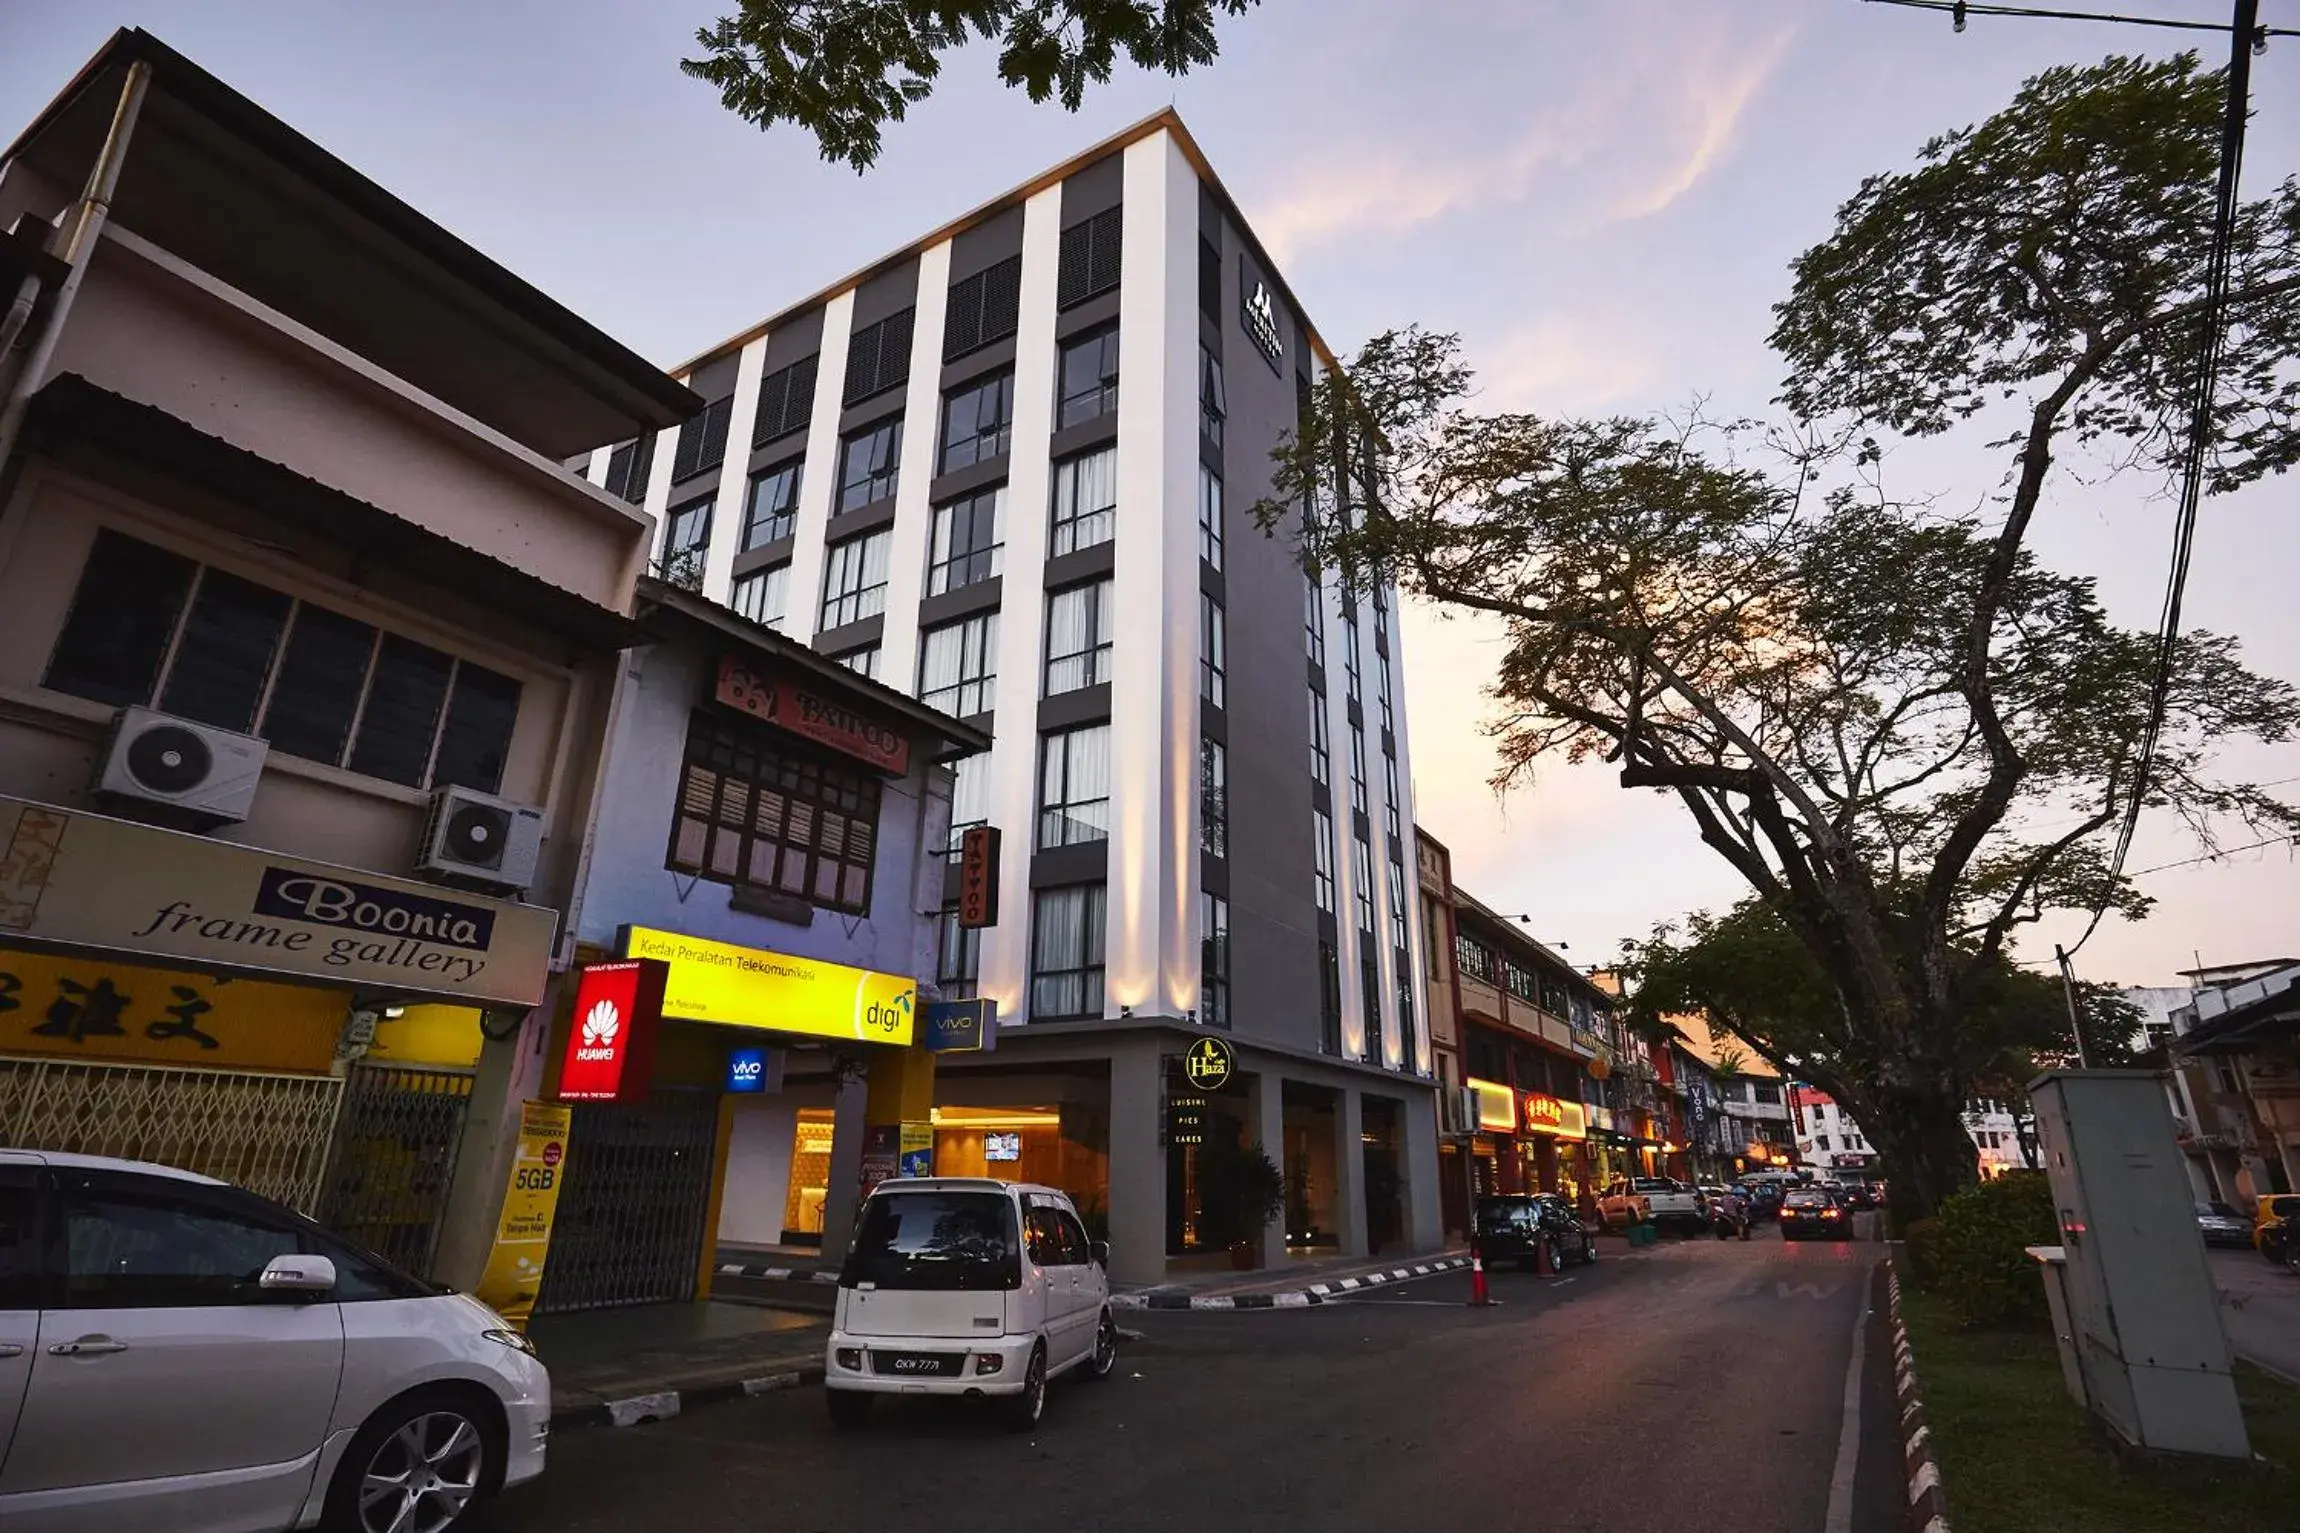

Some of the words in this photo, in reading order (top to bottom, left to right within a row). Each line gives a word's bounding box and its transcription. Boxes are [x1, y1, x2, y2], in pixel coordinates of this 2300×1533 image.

[277, 878, 477, 945] Boonia
[132, 900, 313, 951] frame
[322, 939, 486, 983] gallery
[639, 938, 675, 957] Kedai
[677, 945, 733, 967] Peralatan
[736, 956, 816, 982] Telekomunikasi
[867, 1001, 900, 1033] digi
[576, 1047, 615, 1061] HUAWEI
[1191, 1057, 1226, 1077] Haza
[515, 1168, 554, 1190] 5GB
